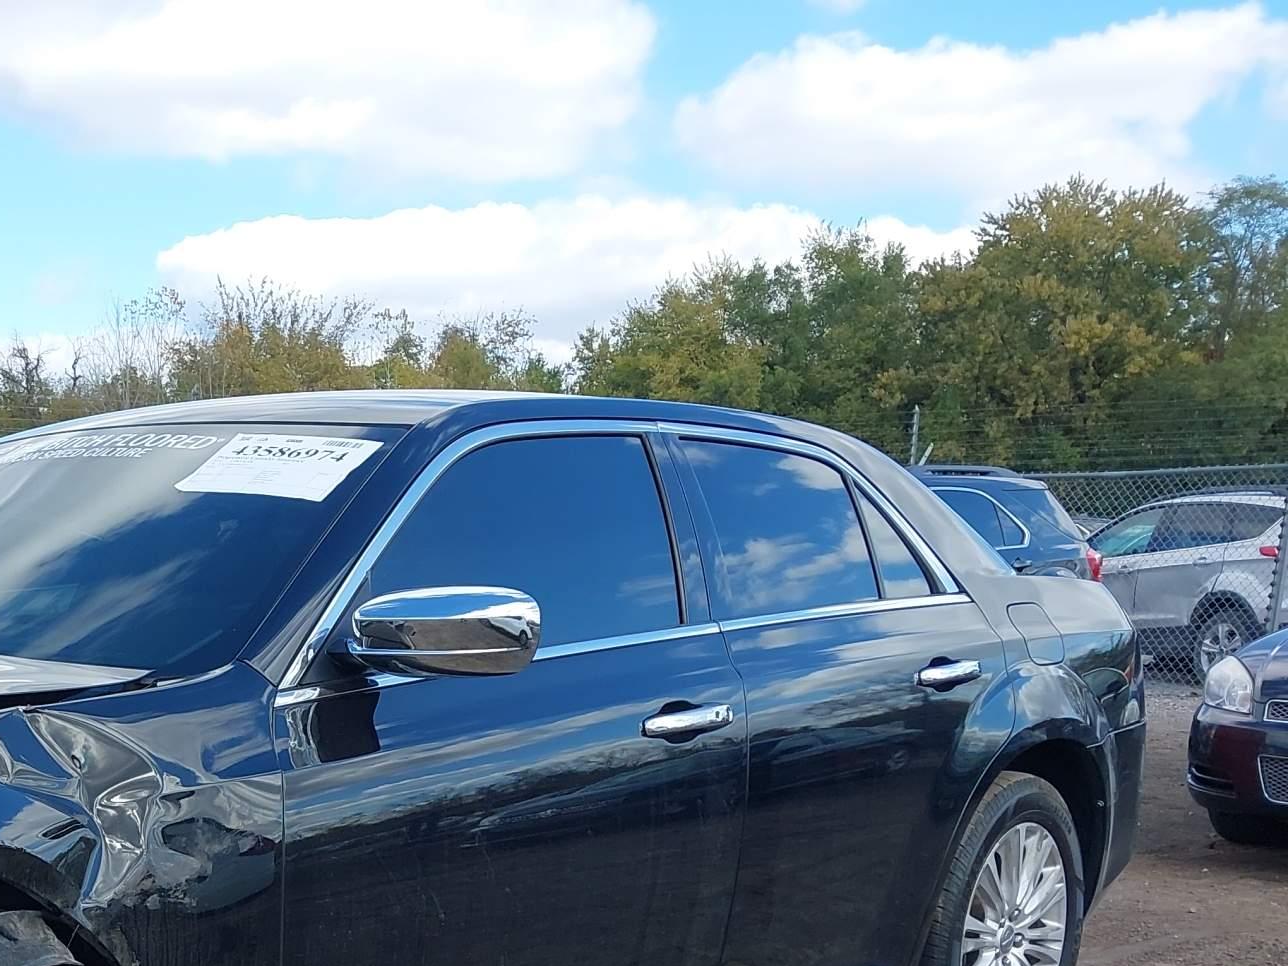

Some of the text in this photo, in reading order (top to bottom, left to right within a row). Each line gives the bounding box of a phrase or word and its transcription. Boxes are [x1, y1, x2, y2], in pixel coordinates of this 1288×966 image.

[103, 433, 218, 449] FLOORED
[38, 448, 86, 459] SPEED
[83, 447, 152, 458] CULTURE
[232, 445, 350, 462] 43586974
